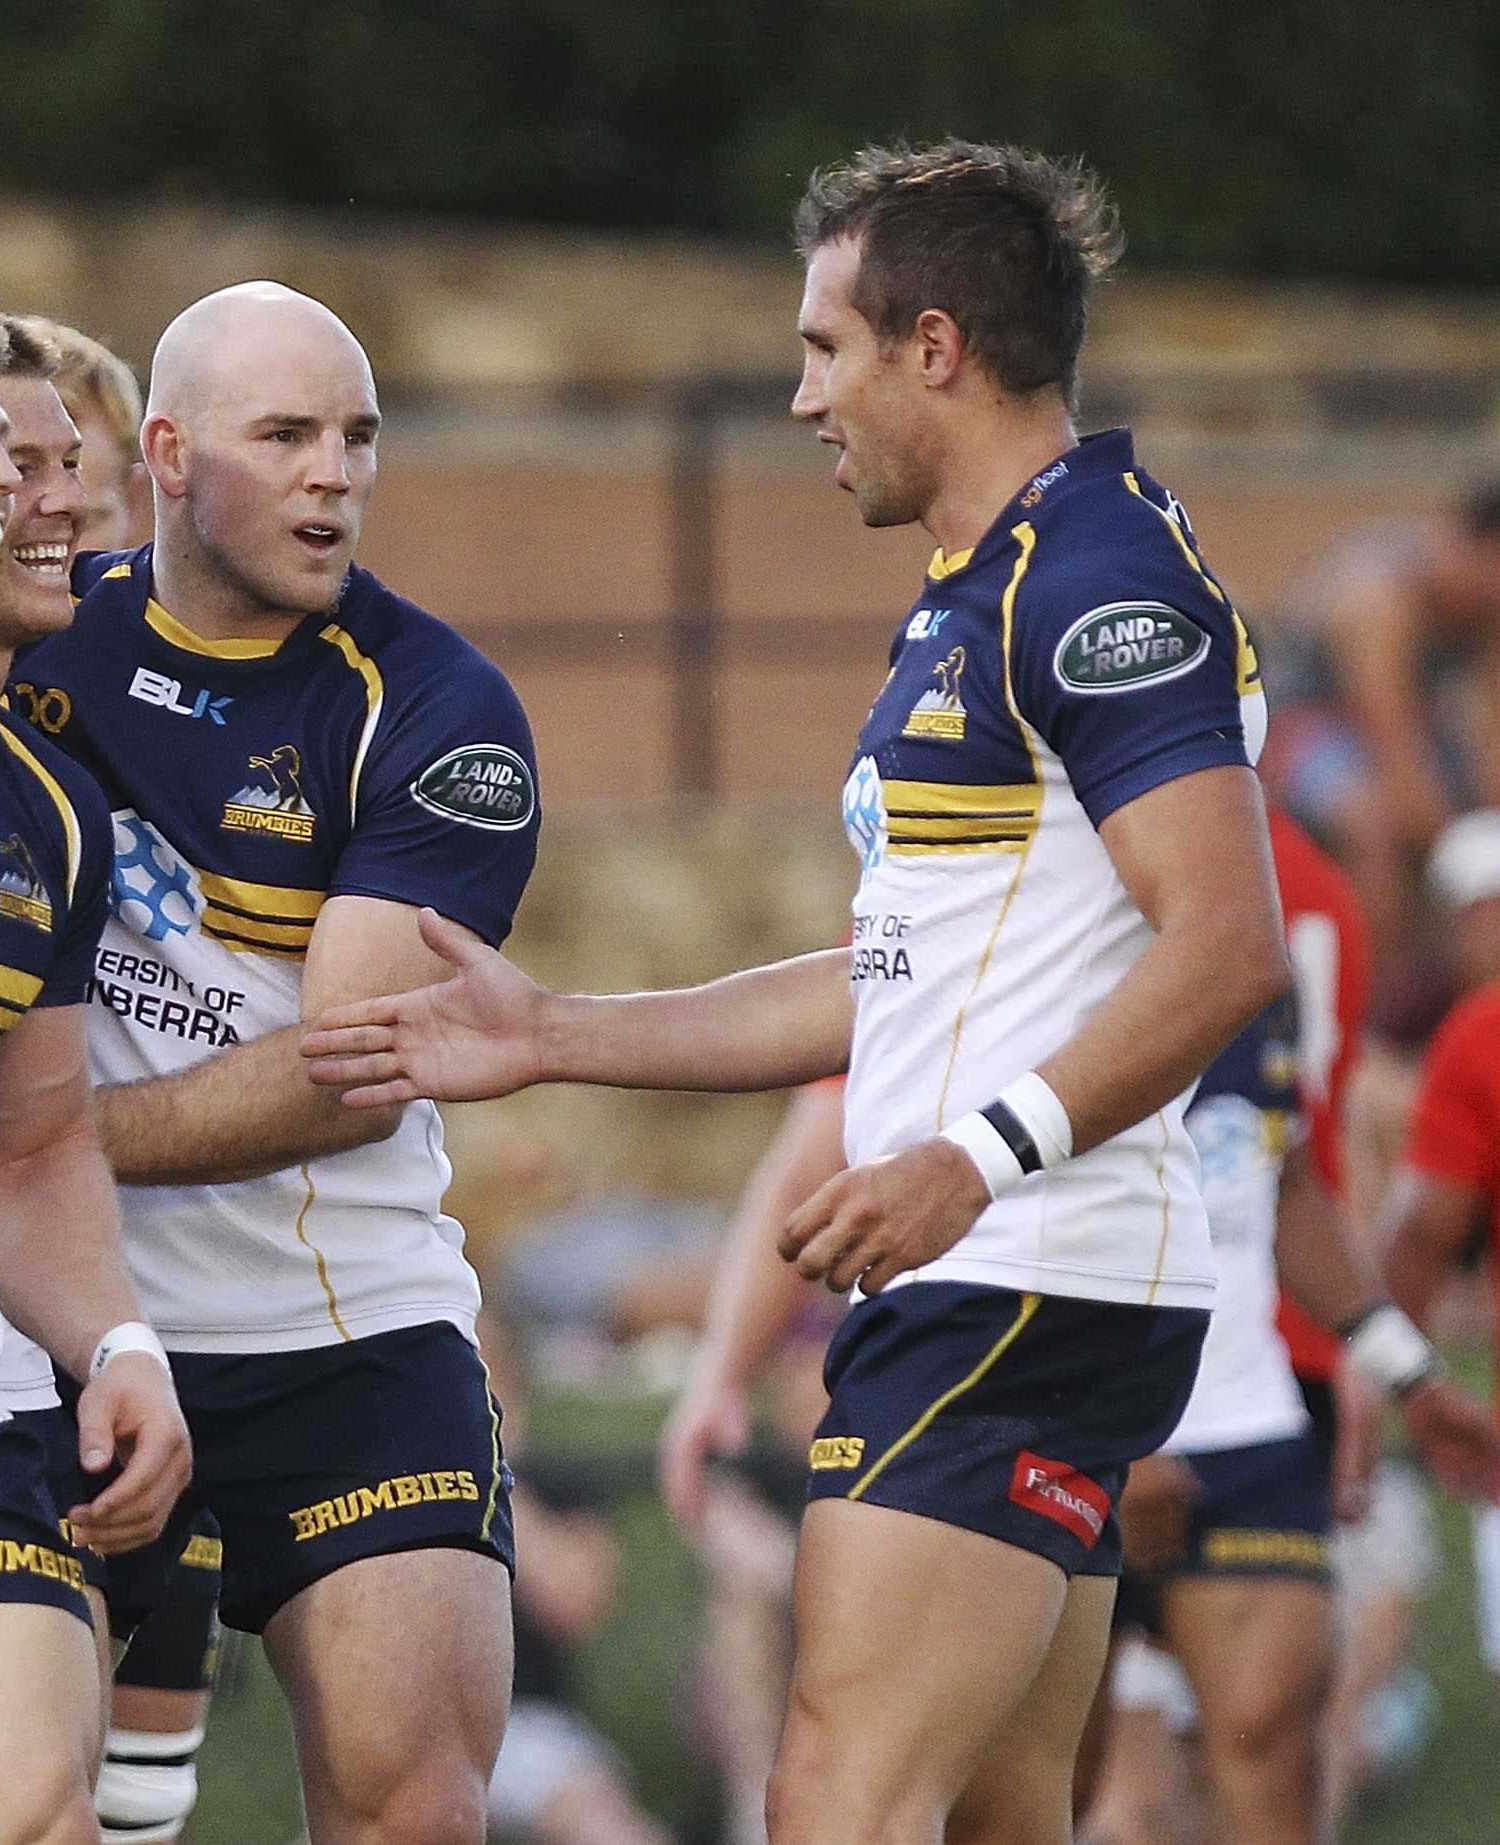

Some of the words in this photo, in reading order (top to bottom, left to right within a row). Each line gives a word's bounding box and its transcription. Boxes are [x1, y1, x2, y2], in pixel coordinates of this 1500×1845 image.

[906, 609, 951, 640] BLK
[128, 667, 234, 726] BLK
[222, 808, 314, 837] BRUMBIES
[882, 914, 912, 938] OF
[204, 986, 246, 1014] OF
[289, 1471, 480, 1542] BRUMBIES
